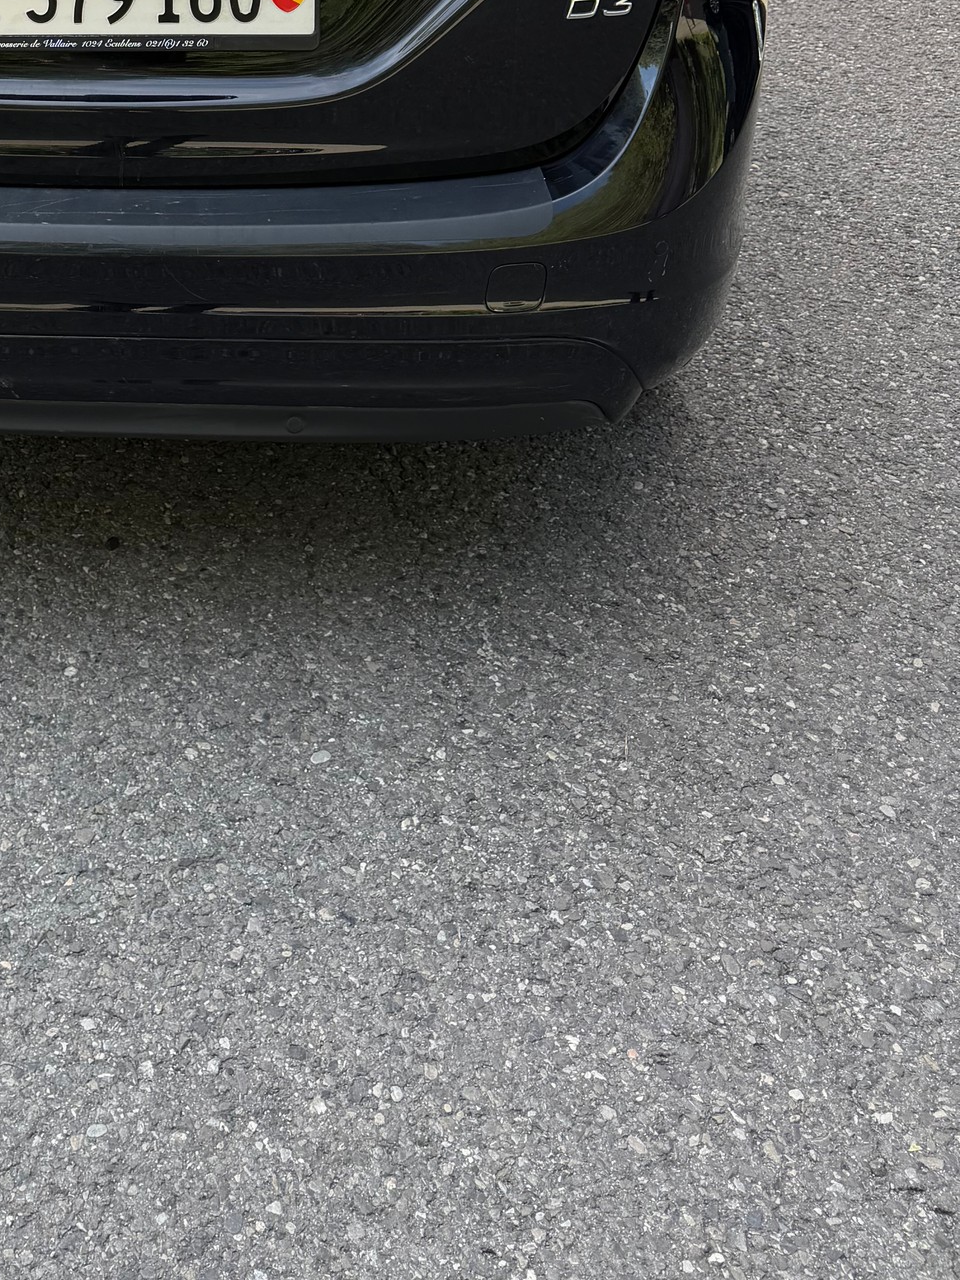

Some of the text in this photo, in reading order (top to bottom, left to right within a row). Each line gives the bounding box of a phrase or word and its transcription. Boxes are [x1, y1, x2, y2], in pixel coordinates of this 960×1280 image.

[29, 39, 41, 49] de
[42, 39, 78, 49] Vallaire
[81, 40, 103, 48] 1024
[104, 39, 142, 48] Ecublens
[182, 40, 194, 48] 32
